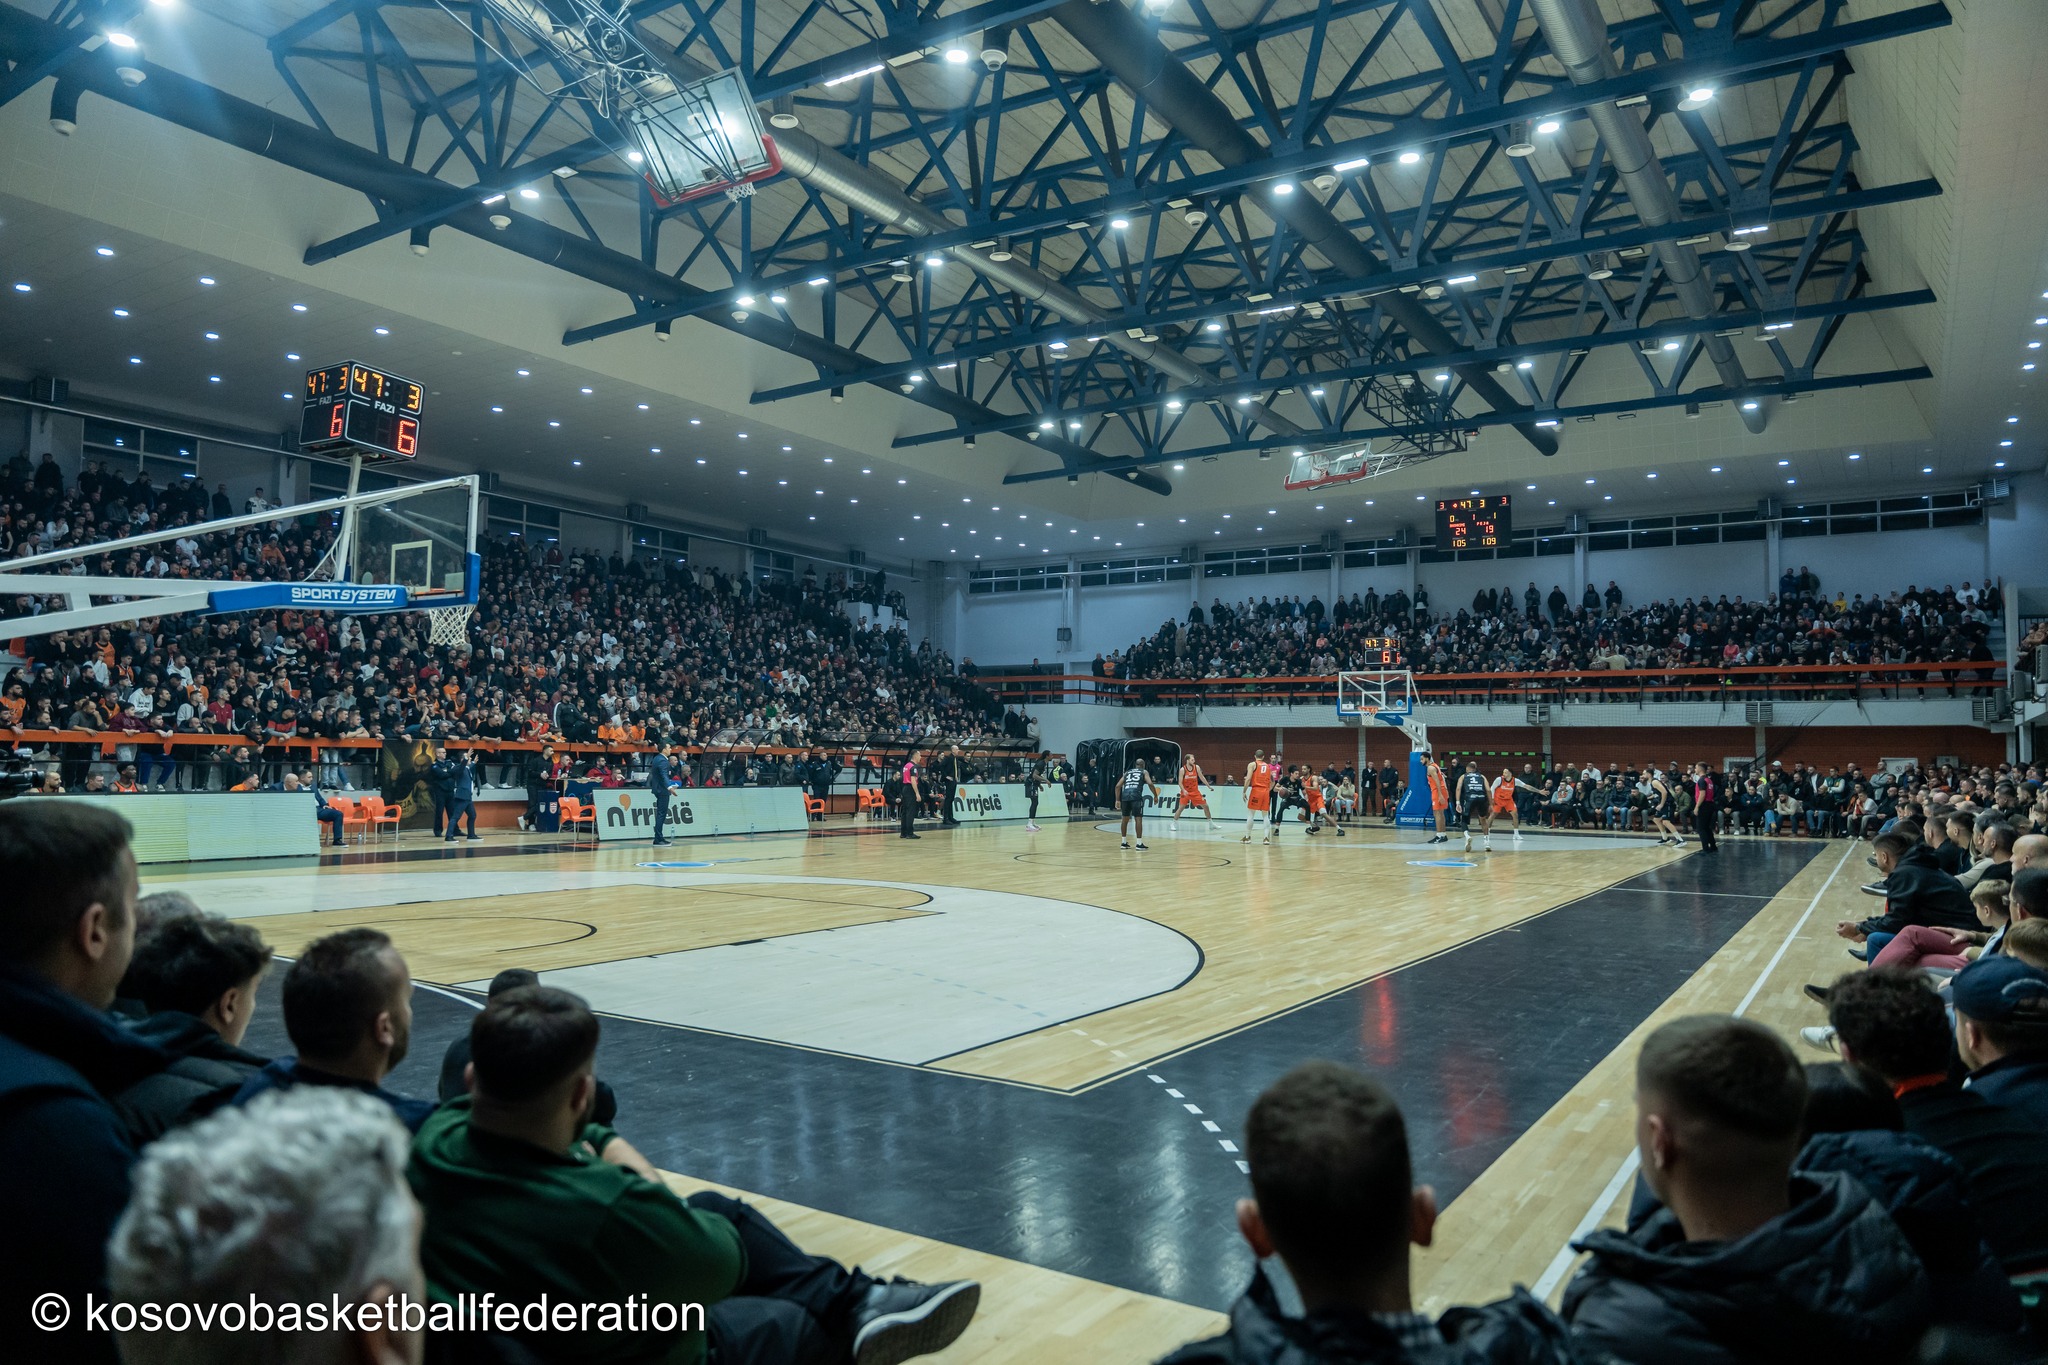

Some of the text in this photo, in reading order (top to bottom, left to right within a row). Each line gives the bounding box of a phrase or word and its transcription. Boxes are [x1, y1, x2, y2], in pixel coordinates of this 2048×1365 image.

[407, 385, 421, 410] 3
[374, 400, 395, 414] FAZI
[329, 403, 344, 437] 6
[397, 419, 416, 454] 6
[1455, 527, 1467, 536] 24
[1485, 525, 1494, 533] 19
[1452, 539, 1467, 547] 105
[1482, 537, 1497, 546] 109
[1382, 651, 1390, 663] 6
[1125, 773, 1141, 782] 13
[1469, 776, 1479, 784] 1
